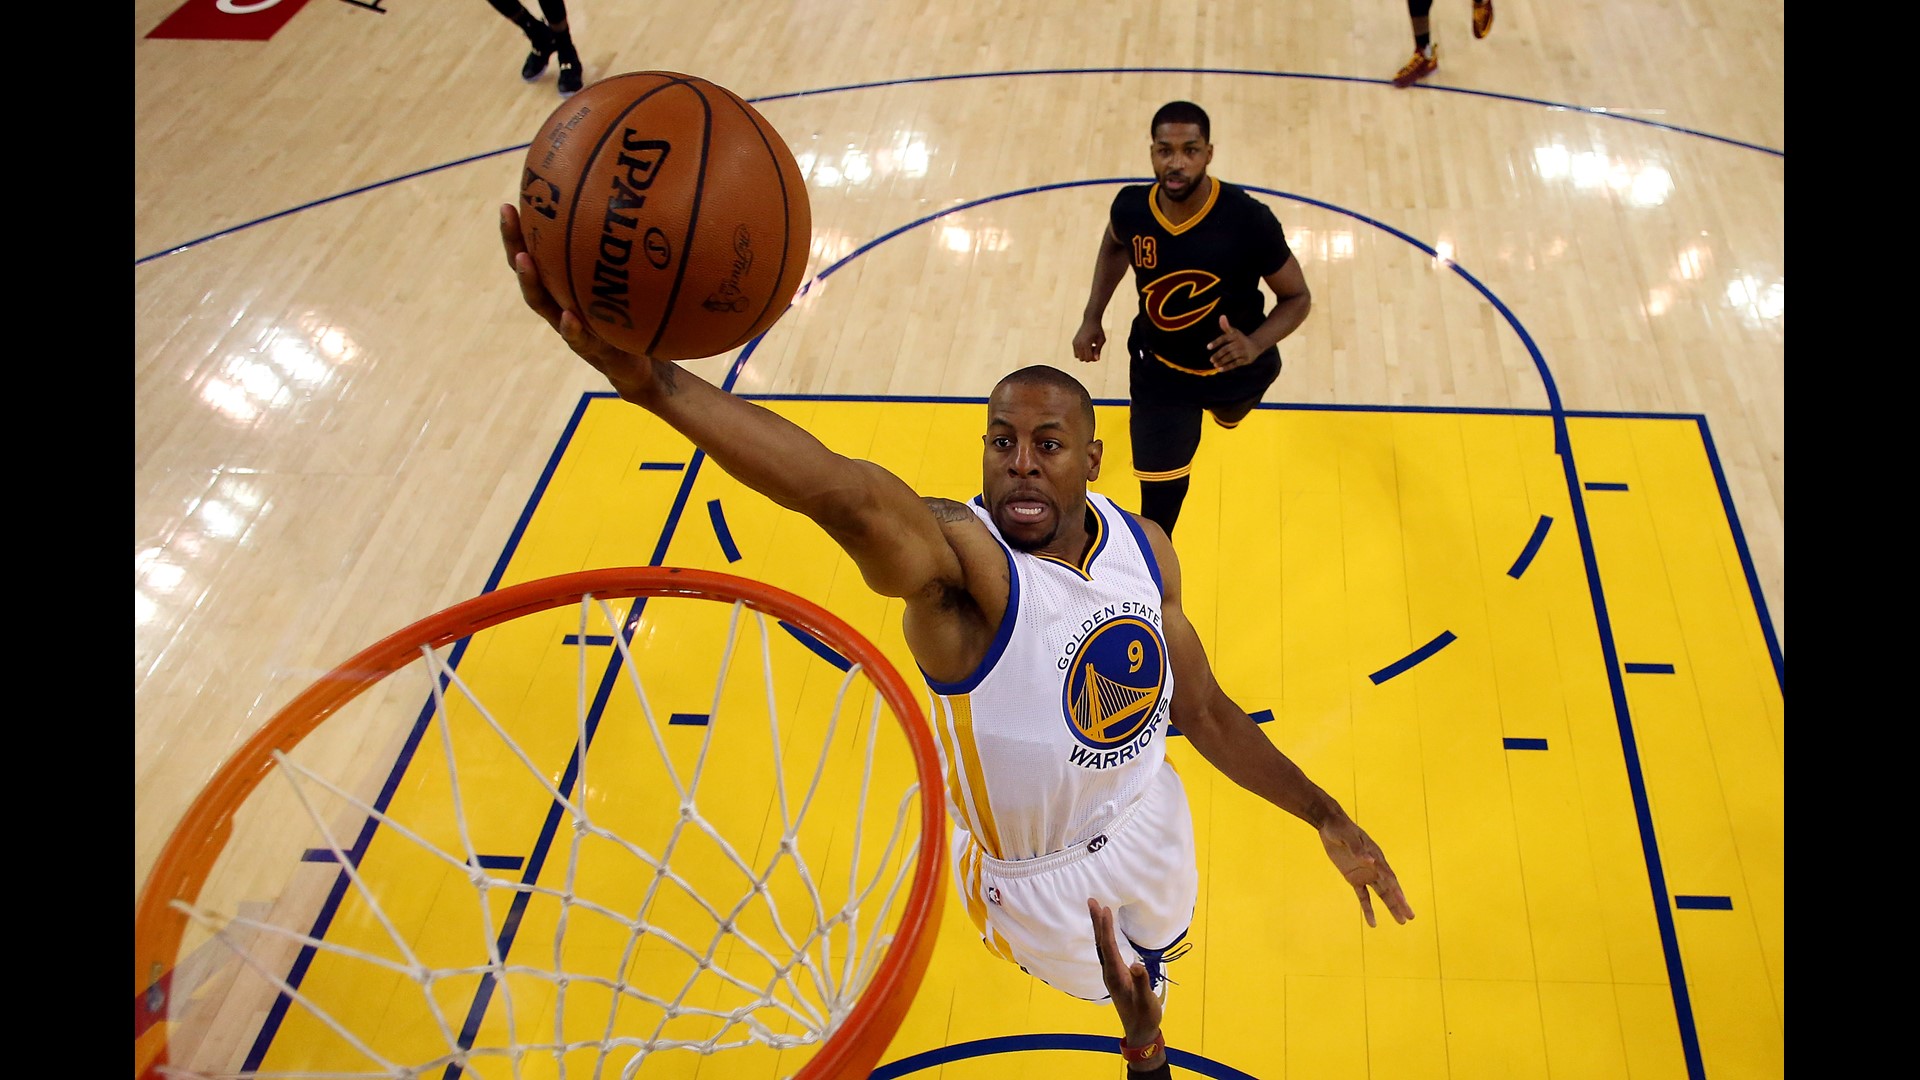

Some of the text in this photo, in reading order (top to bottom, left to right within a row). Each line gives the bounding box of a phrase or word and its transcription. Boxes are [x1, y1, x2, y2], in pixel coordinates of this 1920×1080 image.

[587, 127, 672, 330] SPALDING
[1132, 234, 1157, 269] 13
[1142, 269, 1221, 332] C
[1057, 601, 1161, 671] GOLDEN STATE
[1127, 639, 1144, 674] 9
[1068, 696, 1169, 770] WARRIORS
